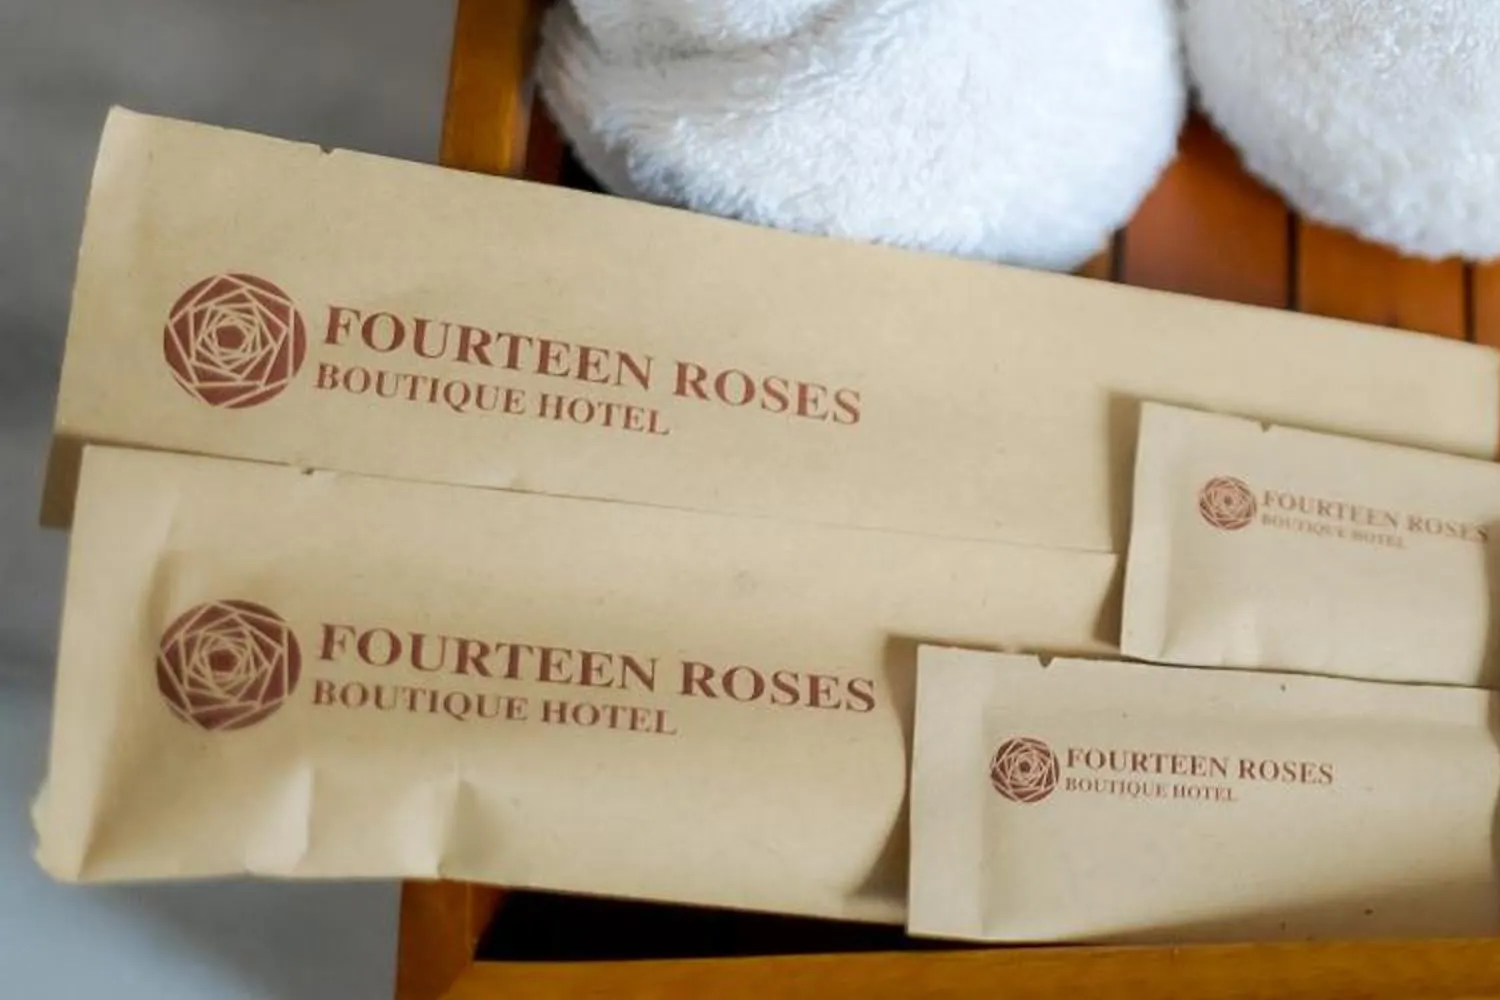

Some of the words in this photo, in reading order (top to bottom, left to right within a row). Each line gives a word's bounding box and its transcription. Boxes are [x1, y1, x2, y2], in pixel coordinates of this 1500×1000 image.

[323, 305, 659, 391] FOURTEEN
[671, 359, 861, 426] ROSES
[314, 362, 526, 416] BOUTIQUE
[537, 394, 671, 437] HOTEL
[1261, 513, 1347, 539] BOUTIQUE
[1262, 489, 1399, 528] FOURTEEN
[1406, 513, 1491, 543] ROSES
[319, 623, 659, 692] FOURTEEN
[680, 660, 877, 713] ROSES
[312, 678, 528, 722] BOUTIQUE
[539, 700, 678, 736] HOTEL
[1065, 777, 1169, 799] BOUTIQUE
[1173, 785, 1238, 801] HOTEL
[1066, 748, 1230, 778] FOURTEEN
[1238, 758, 1335, 785] ROSES
